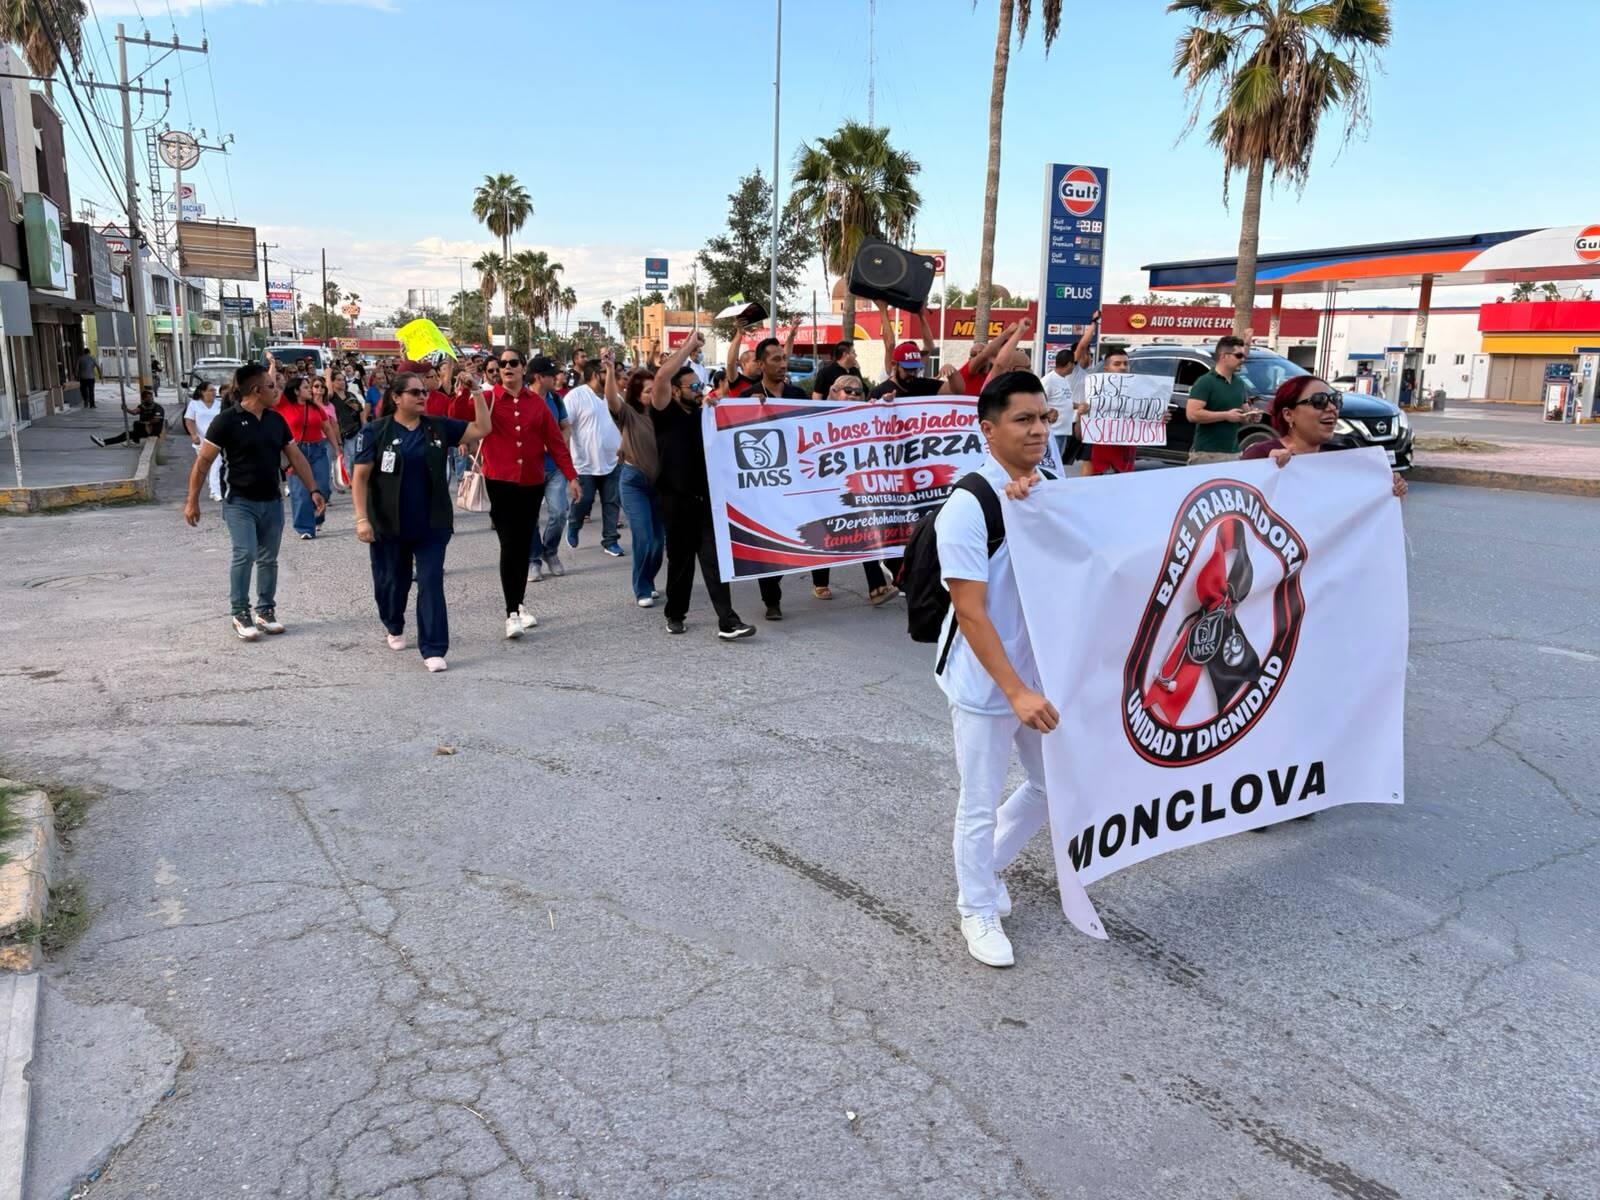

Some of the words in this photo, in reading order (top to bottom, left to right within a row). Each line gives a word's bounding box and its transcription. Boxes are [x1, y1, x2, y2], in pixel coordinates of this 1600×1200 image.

[1061, 183, 1099, 199] Gulf
[170, 203, 203, 212] FAMACIAS
[1150, 316, 1174, 327] AUTO
[1176, 317, 1213, 328] SERVICE
[1214, 318, 1236, 329] EXPE
[797, 426, 825, 453] La
[828, 422, 870, 443] base
[871, 409, 979, 434] trabajador
[818, 452, 848, 478] ES
[854, 445, 879, 471] LA
[884, 434, 983, 464] FUERZA
[737, 468, 793, 489] IMSS
[861, 474, 904, 493] UMF
[912, 470, 934, 489] 9
[1157, 526, 1192, 606] BASE
[1188, 487, 1304, 578] TRABAJADORA
[1192, 641, 1216, 657] IMSS
[1127, 688, 1175, 757] UNIDAD
[1180, 733, 1193, 758] Y
[1197, 655, 1284, 753] DIGNIDAD
[1067, 761, 1327, 872] MONCLOVA
